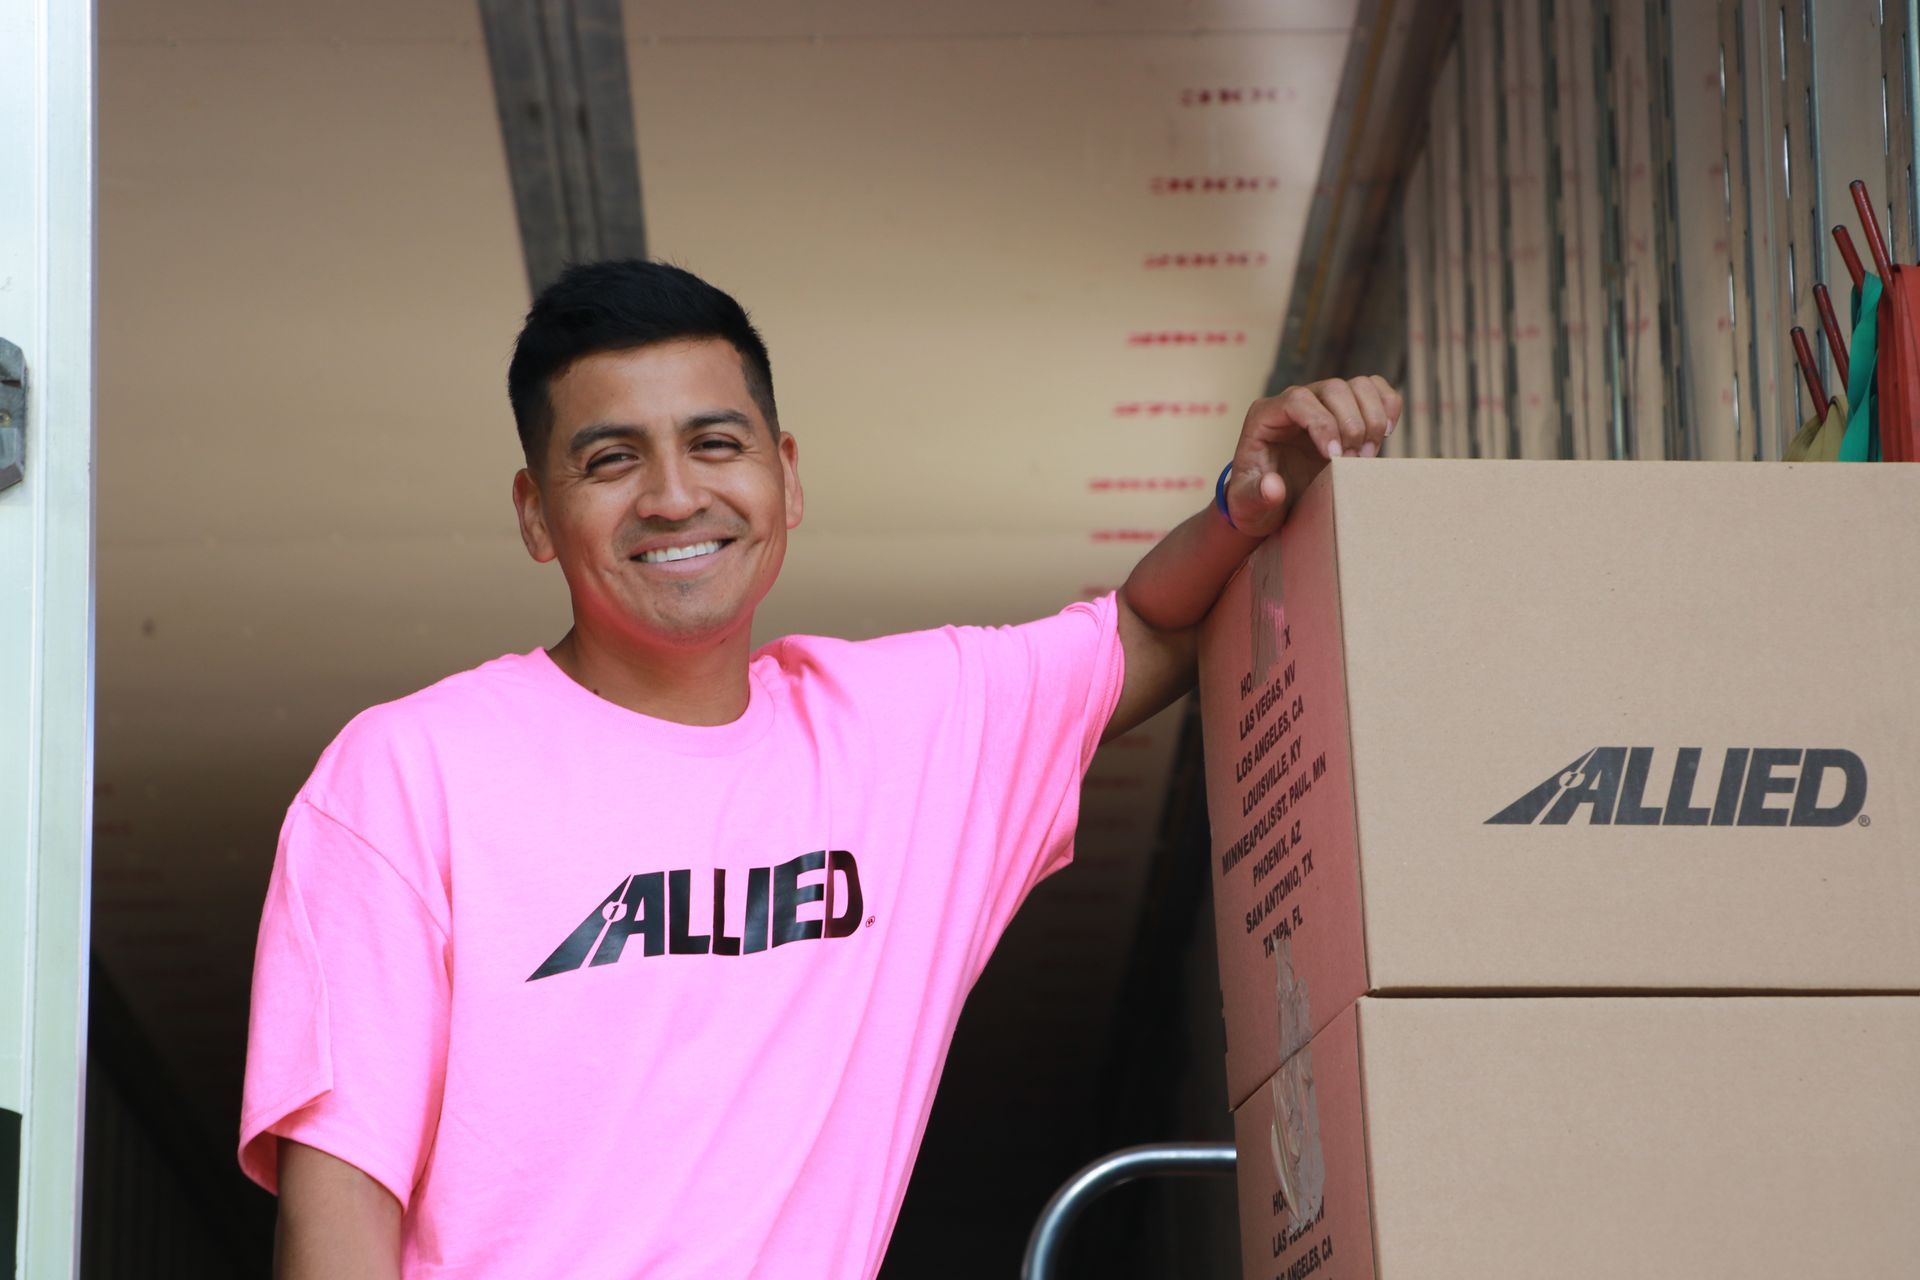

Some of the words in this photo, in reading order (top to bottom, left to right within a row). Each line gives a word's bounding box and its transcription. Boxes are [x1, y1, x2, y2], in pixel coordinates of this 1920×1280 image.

[1236, 751, 1253, 785] LOS
[1254, 710, 1291, 767] ANGELES,
[1292, 693, 1304, 723] CA
[1239, 708, 1255, 741] LAS
[1255, 677, 1284, 722] VEGAS,
[1284, 659, 1295, 692] NV
[1242, 752, 1289, 818] LOUISVILLE,
[1290, 734, 1302, 767] KY
[1289, 770, 1312, 808] PAUL,
[1312, 751, 1327, 782] MN
[1482, 746, 1868, 827] ALLIED
[1245, 901, 1263, 935] SAN
[1264, 865, 1301, 918] ANTONIO,
[1302, 848, 1314, 878] TX
[1253, 834, 1290, 888] PHOENIX,
[1290, 819, 1302, 849] AZ
[525, 850, 864, 983] ALLIED
[1292, 904, 1303, 931] FL
[1272, 1228, 1287, 1259] LAS
[1321, 1234, 1334, 1262] CA
